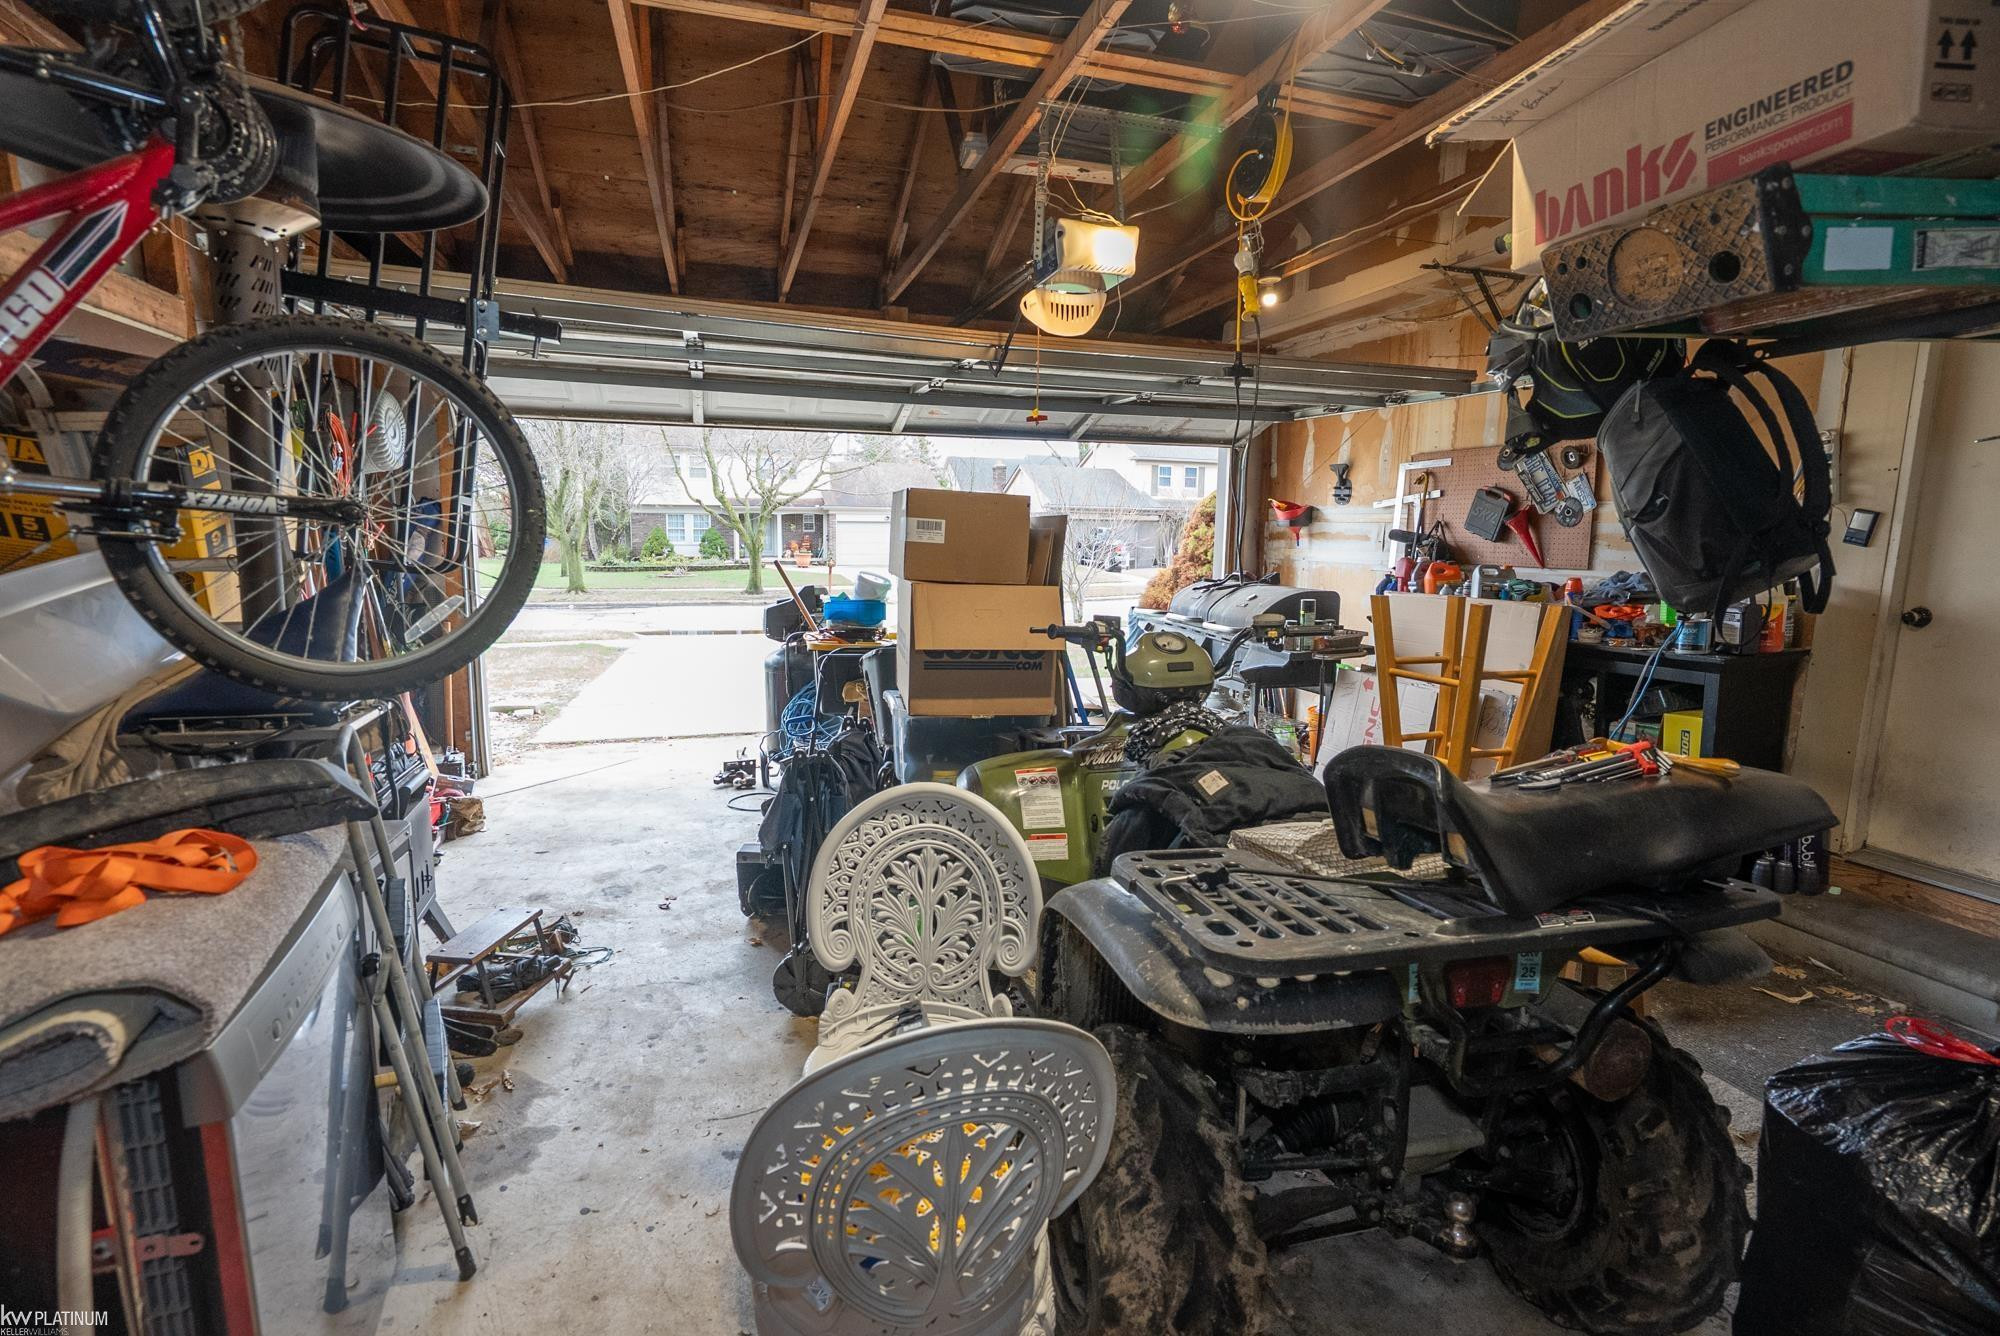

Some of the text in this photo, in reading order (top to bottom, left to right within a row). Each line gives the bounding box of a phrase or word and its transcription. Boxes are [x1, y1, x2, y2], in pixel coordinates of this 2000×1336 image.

[1704, 81, 1854, 153] PERFORMANCE PRODUCT
[1705, 60, 1854, 141] ENGINEERED
[1738, 117, 1844, 166] bankspower.com
[182, 491, 277, 513] VORTEX
[1521, 966, 1537, 978] 25
